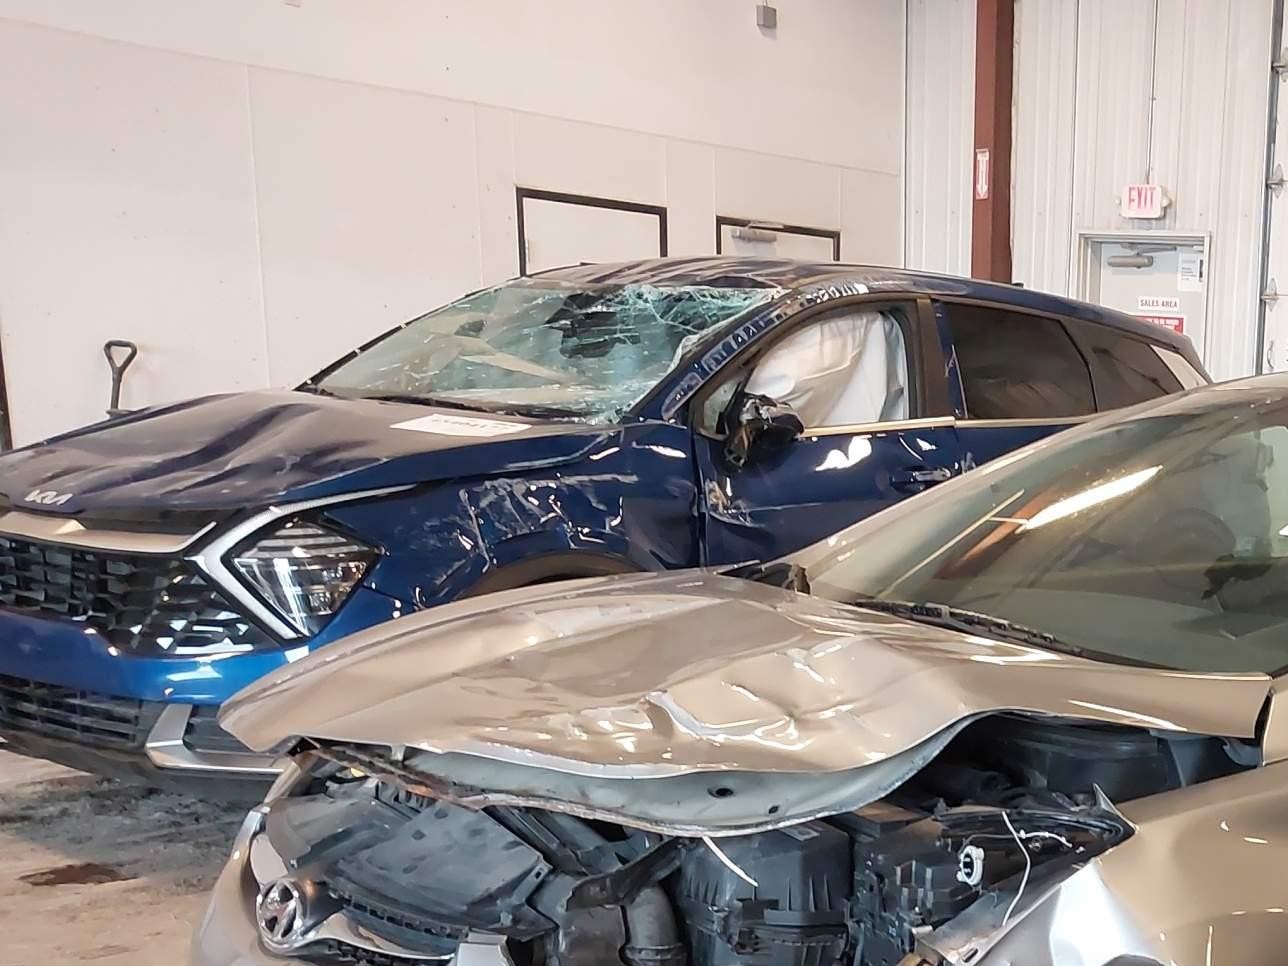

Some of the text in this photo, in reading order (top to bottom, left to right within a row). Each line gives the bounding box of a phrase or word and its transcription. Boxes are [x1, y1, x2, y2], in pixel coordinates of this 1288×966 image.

[1128, 186, 1157, 209] EXIT
[1140, 299, 1178, 308] SALES AREA
